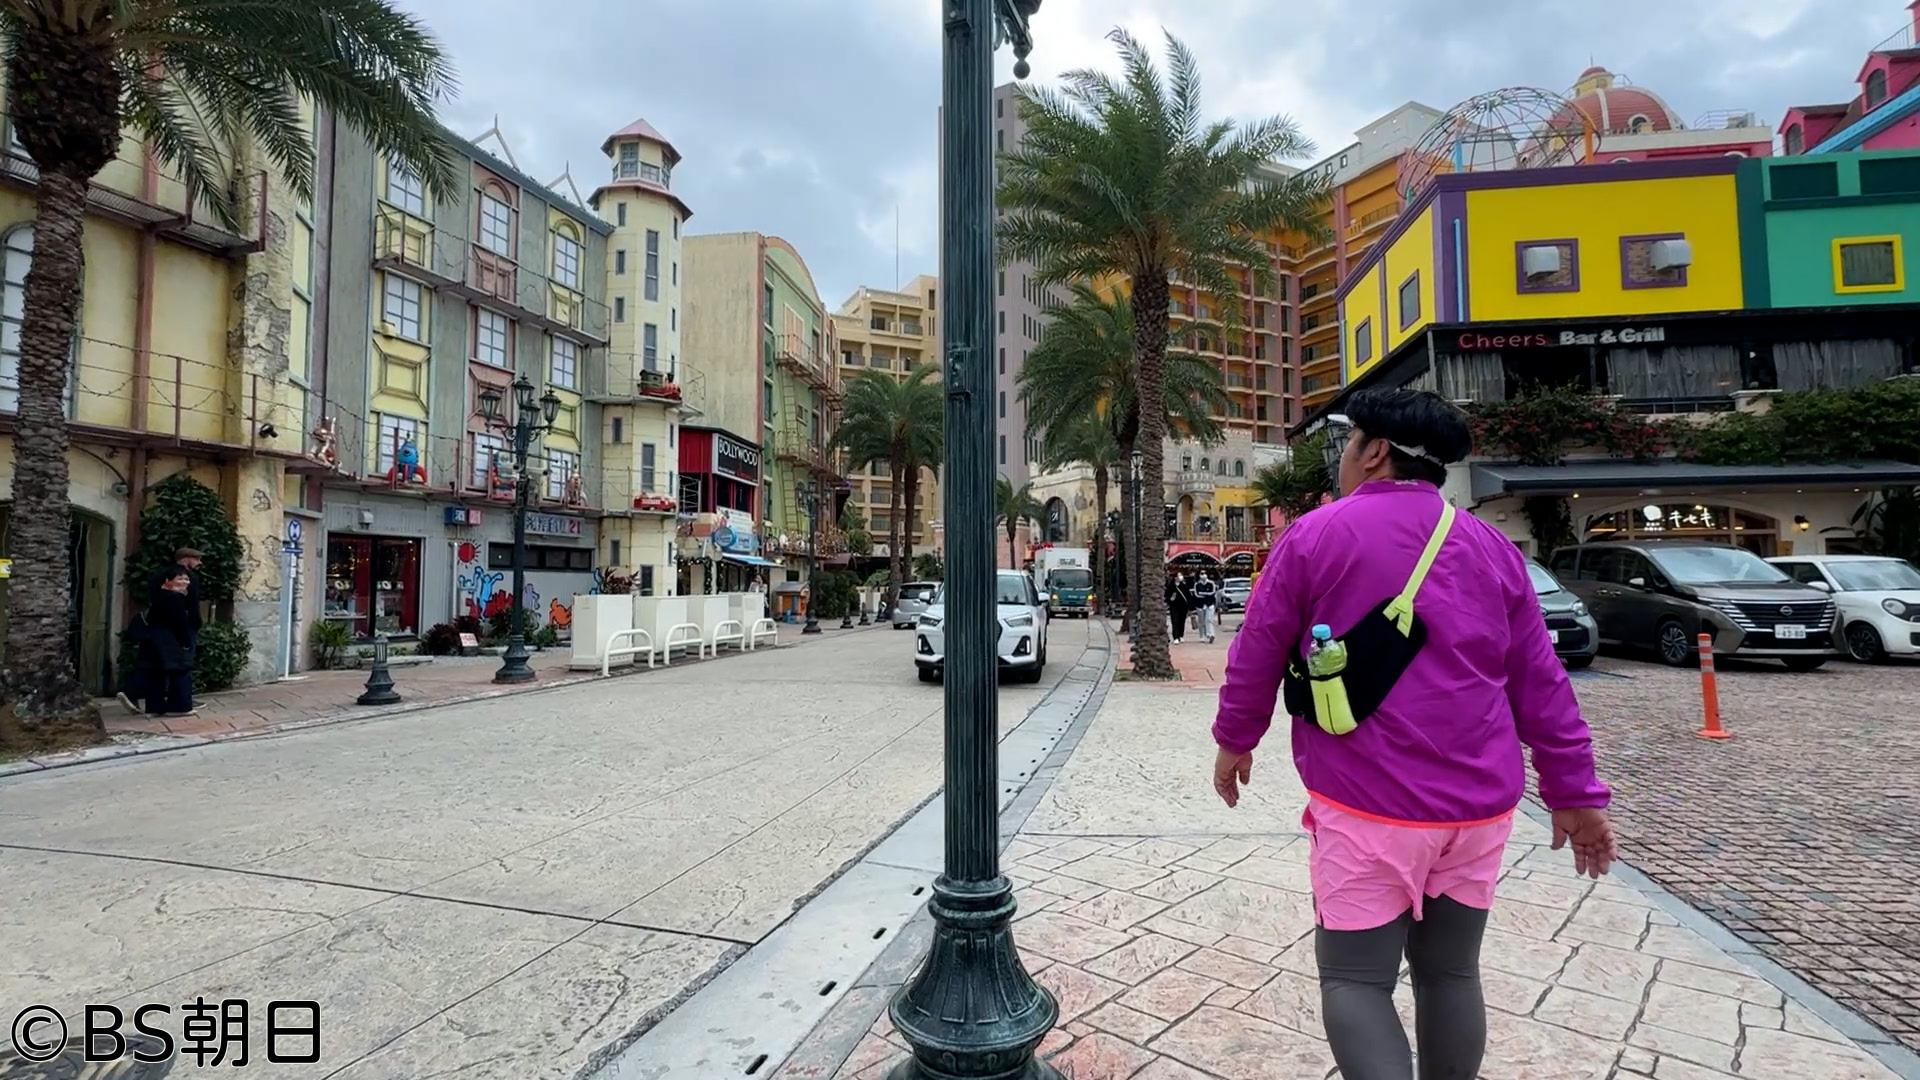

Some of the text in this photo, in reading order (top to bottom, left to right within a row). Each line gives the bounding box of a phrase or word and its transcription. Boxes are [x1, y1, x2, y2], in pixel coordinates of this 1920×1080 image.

[1458, 327, 1665, 349] Cheers Bar & Grill
[718, 438, 758, 466] BOLLYWOOD
[1669, 507, 1713, 528] キセキ
